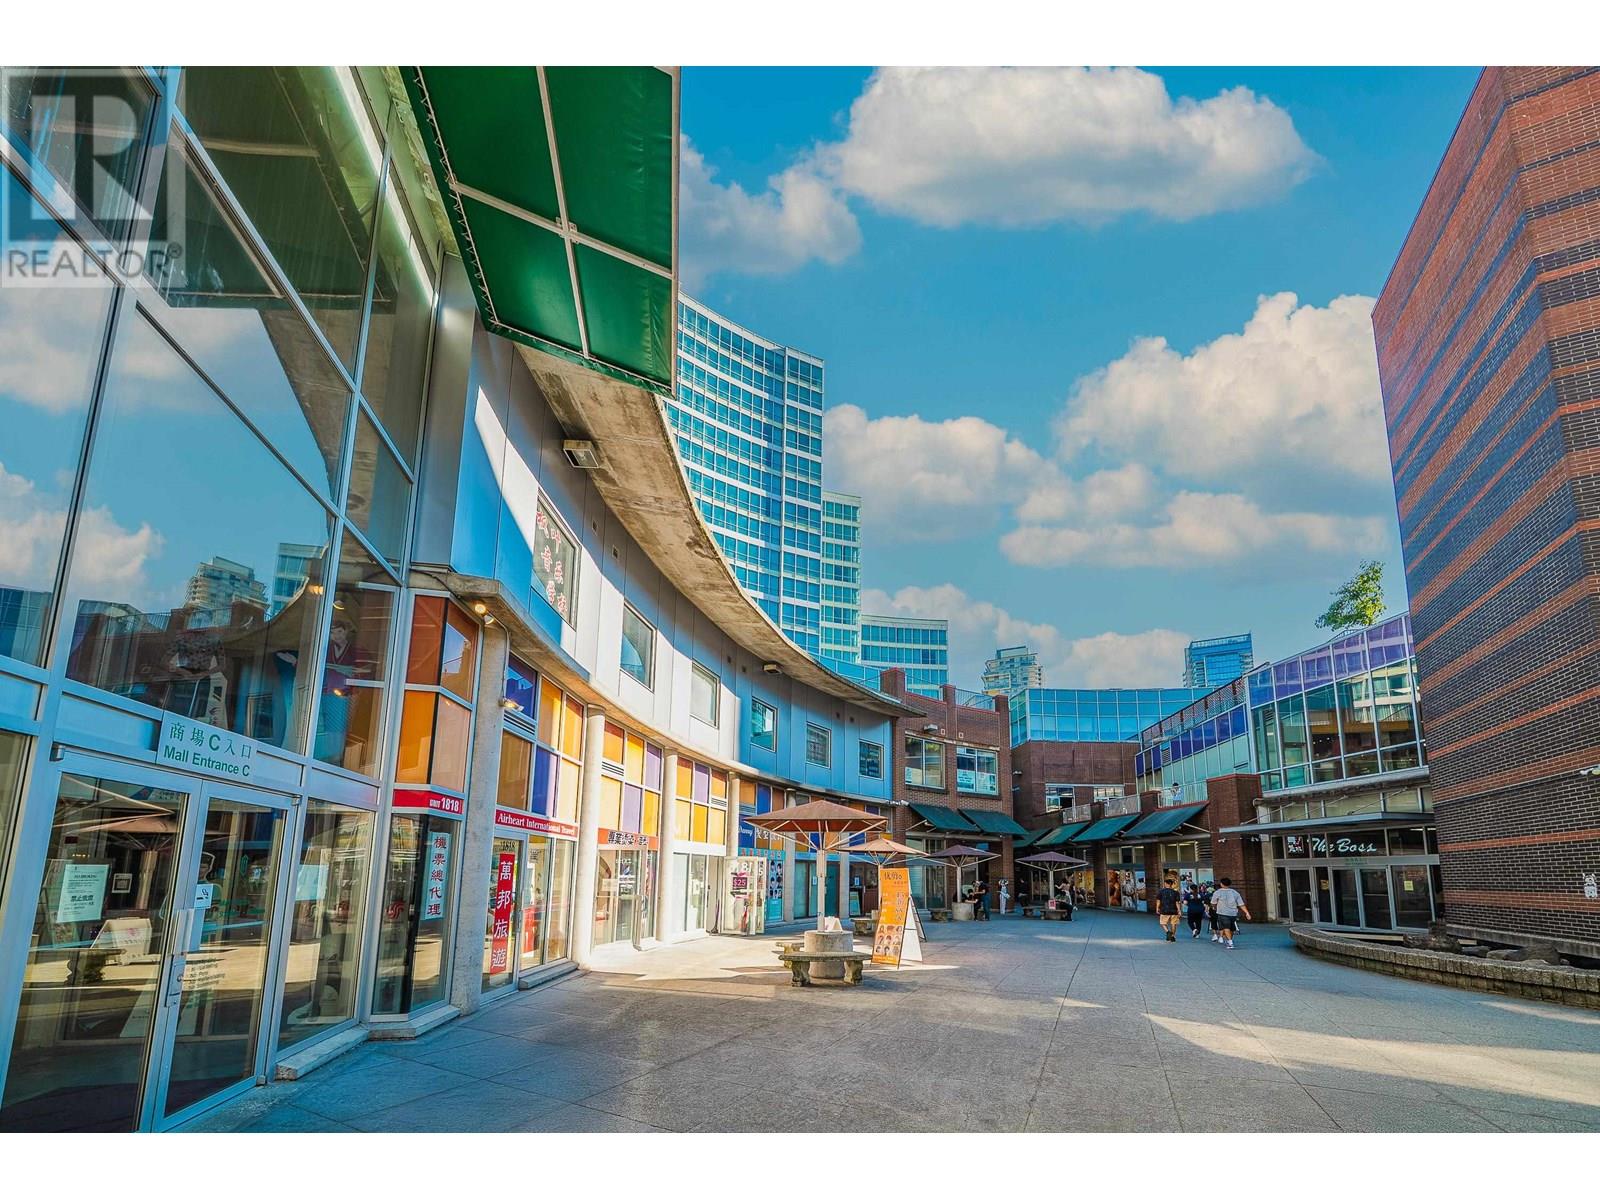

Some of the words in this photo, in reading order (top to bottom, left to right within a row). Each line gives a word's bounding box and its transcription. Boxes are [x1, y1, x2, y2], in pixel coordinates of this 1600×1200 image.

[163, 745, 189, 763] Mall
[192, 752, 240, 775] Entrance
[242, 764, 251, 777] C
[441, 797, 459, 812] 1818
[497, 813, 526, 828] Airheart
[526, 818, 561, 834] International
[1307, 837, 1335, 853] The
[1336, 838, 1378, 853] Boss
[426, 836, 448, 916] 機票總代理
[733, 879, 747, 888] $25
[491, 861, 513, 969] 萬邦旅遊
